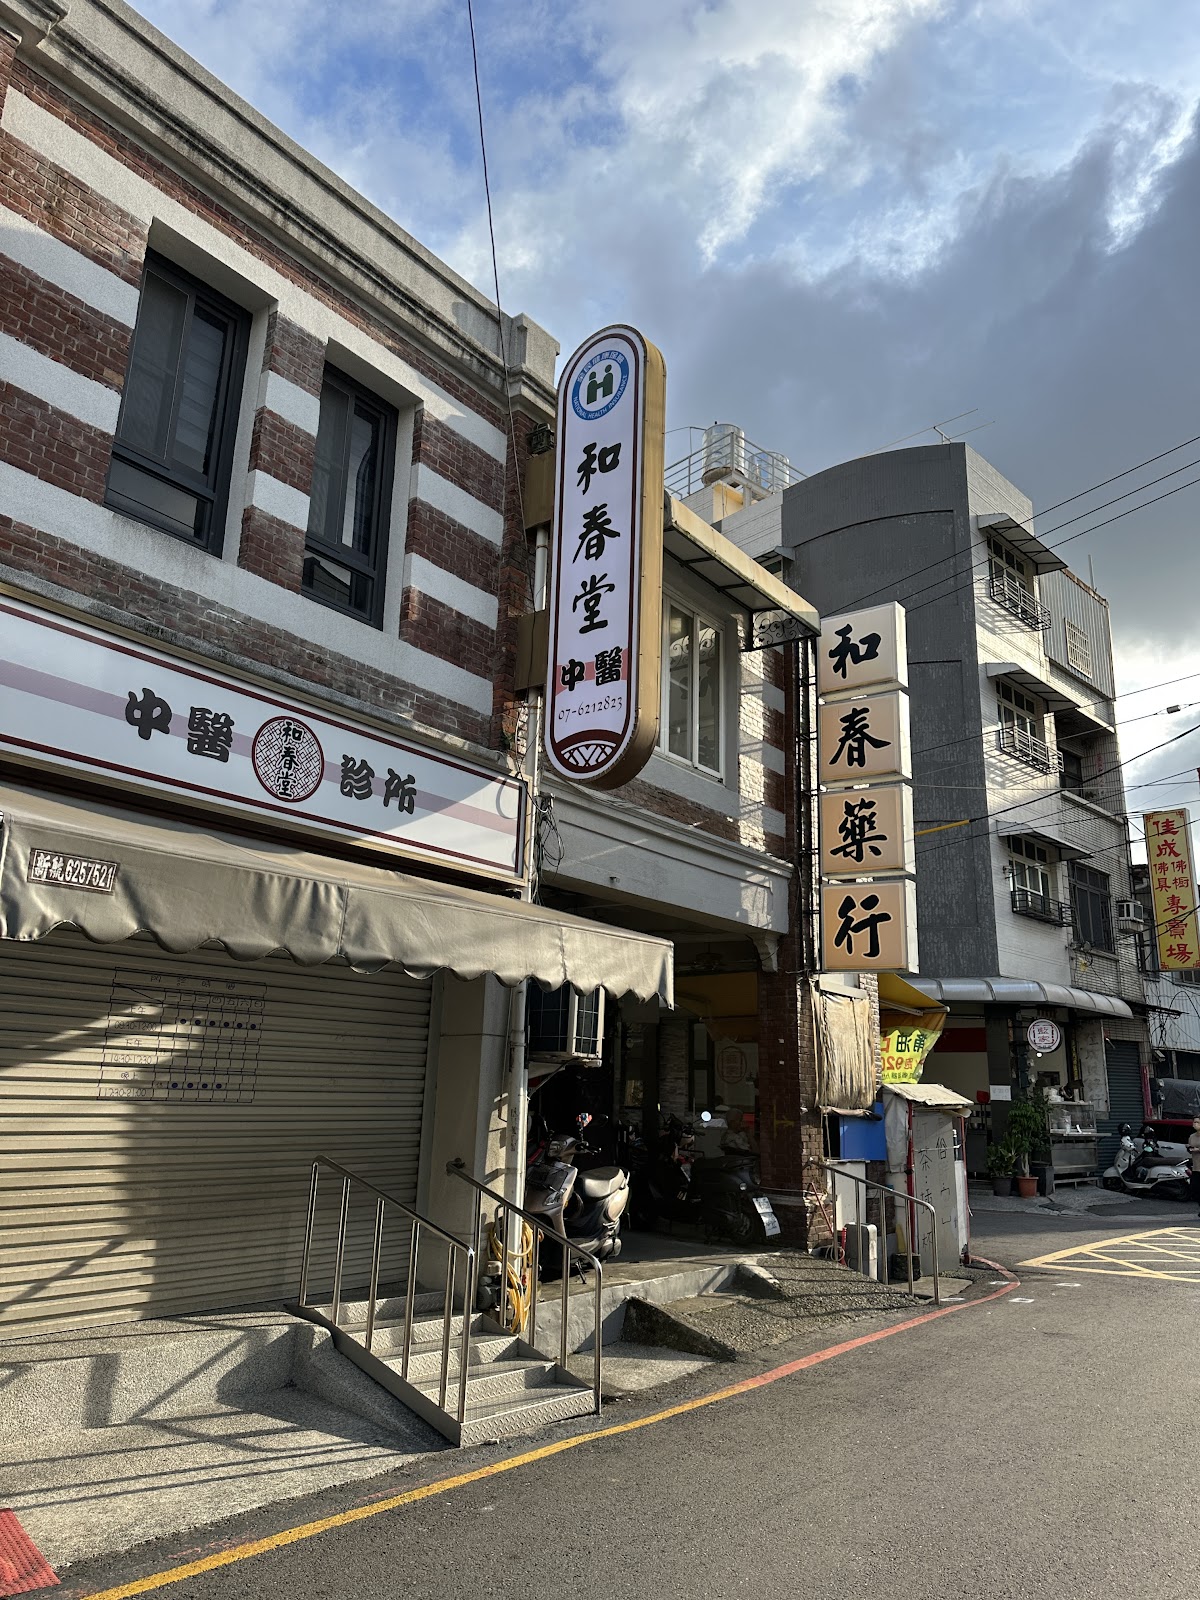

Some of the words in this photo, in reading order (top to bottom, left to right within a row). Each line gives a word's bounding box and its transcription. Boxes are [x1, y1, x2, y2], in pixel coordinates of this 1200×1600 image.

[573, 396, 588, 419] NATIONAL
[588, 408, 607, 419] HEALTH
[608, 374, 628, 409] INSURANCE
[572, 441, 622, 635] 和春堂
[561, 646, 623, 692] 中醫
[558, 695, 623, 723] 07-6212823
[125, 687, 236, 763] 中醫
[339, 754, 418, 815] 診所
[276, 719, 304, 800] 和春堂
[828, 623, 892, 959] 和春藥行
[1152, 818, 1181, 859] 佳成
[1153, 863, 1172, 892] 佛具
[1162, 894, 1194, 964] 專賣場
